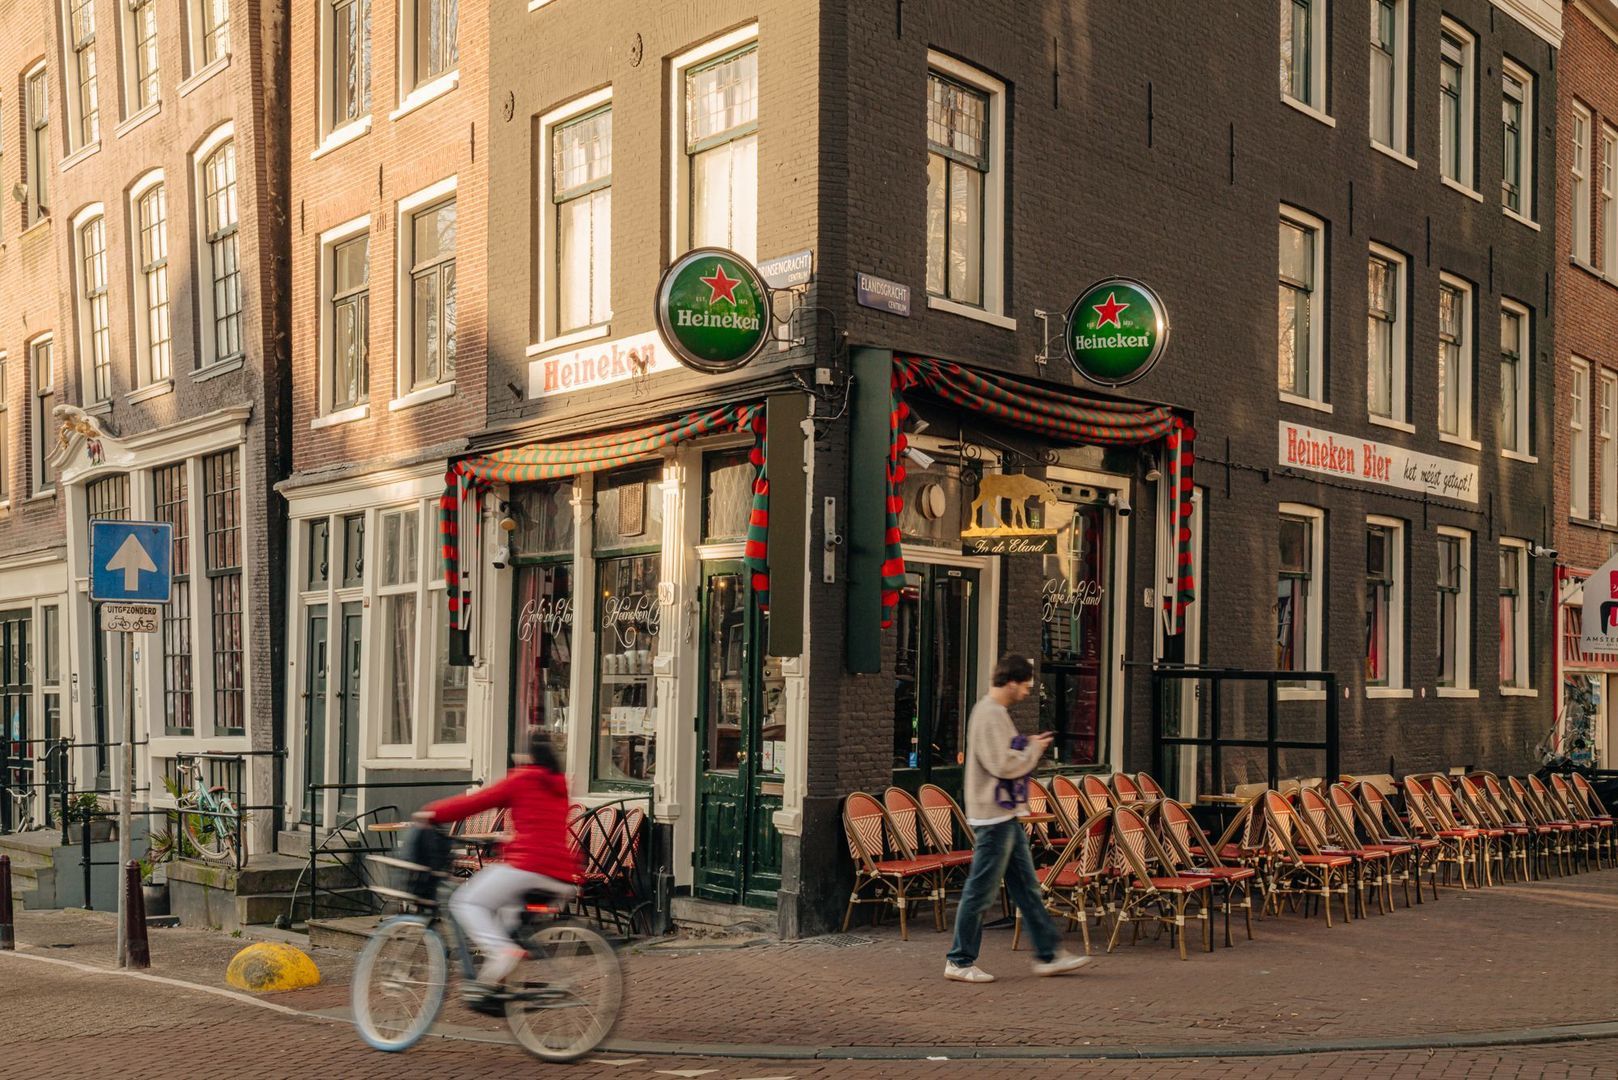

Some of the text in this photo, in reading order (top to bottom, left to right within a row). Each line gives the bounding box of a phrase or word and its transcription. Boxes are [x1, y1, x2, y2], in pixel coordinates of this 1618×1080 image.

[788, 271, 809, 282] CENTRUM
[861, 277, 907, 301] ELANDSGRACHT
[888, 301, 907, 312] CENTRUM
[677, 309, 760, 330] Heineken
[1075, 333, 1150, 350] Heineken
[1287, 427, 1355, 474] Heineken
[1363, 443, 1392, 482] Bier
[1403, 457, 1418, 481] het
[1443, 472, 1473, 497] getapt!
[973, 538, 1048, 553] In de Eland
